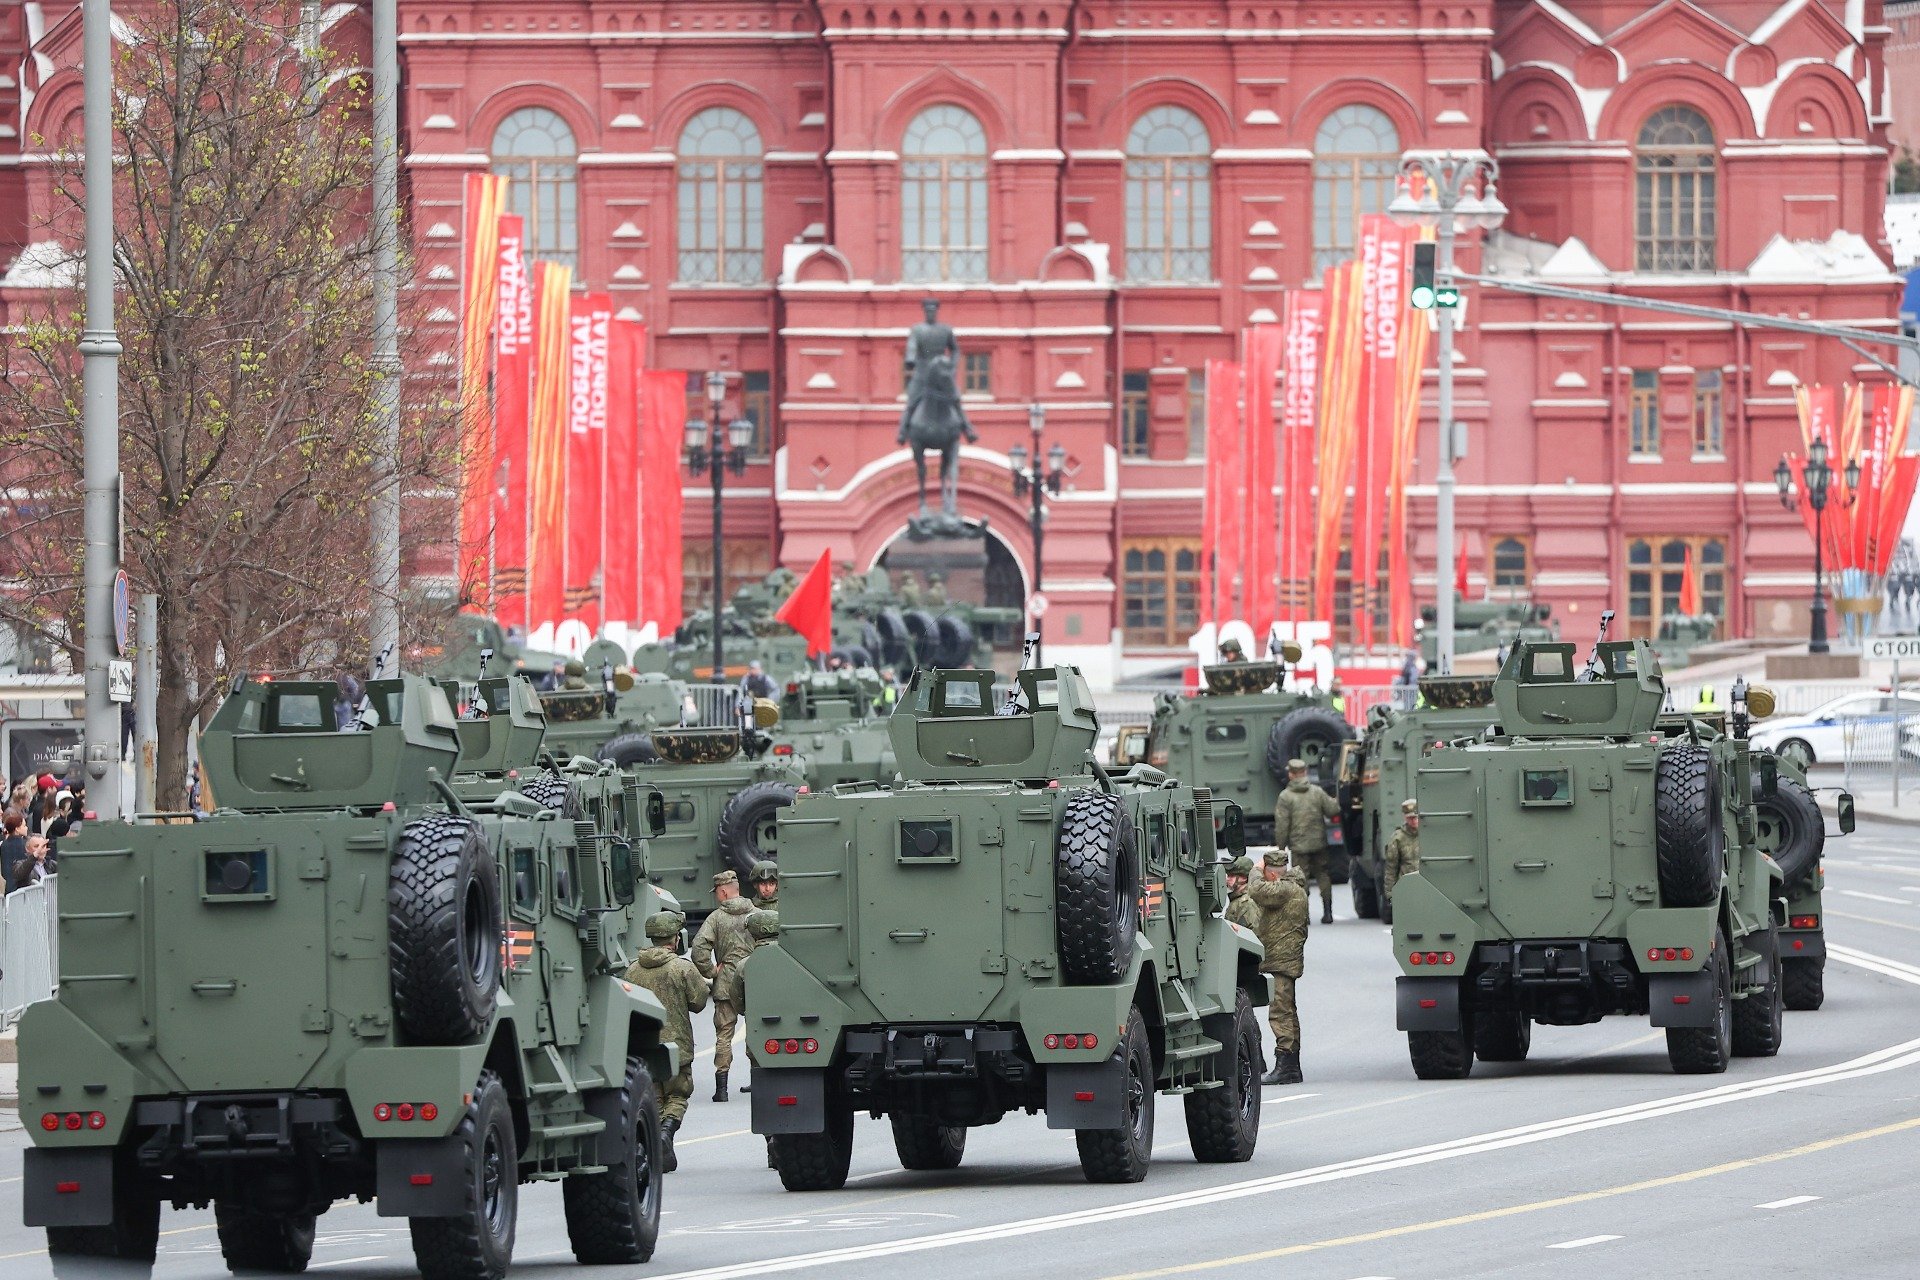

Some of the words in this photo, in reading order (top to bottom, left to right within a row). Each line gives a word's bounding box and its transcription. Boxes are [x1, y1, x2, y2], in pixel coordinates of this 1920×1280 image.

[500, 237, 519, 355] ПОБЕДА!
[571, 315, 592, 434] ПОБЕДА!
[1873, 641, 1920, 656] СТОП
